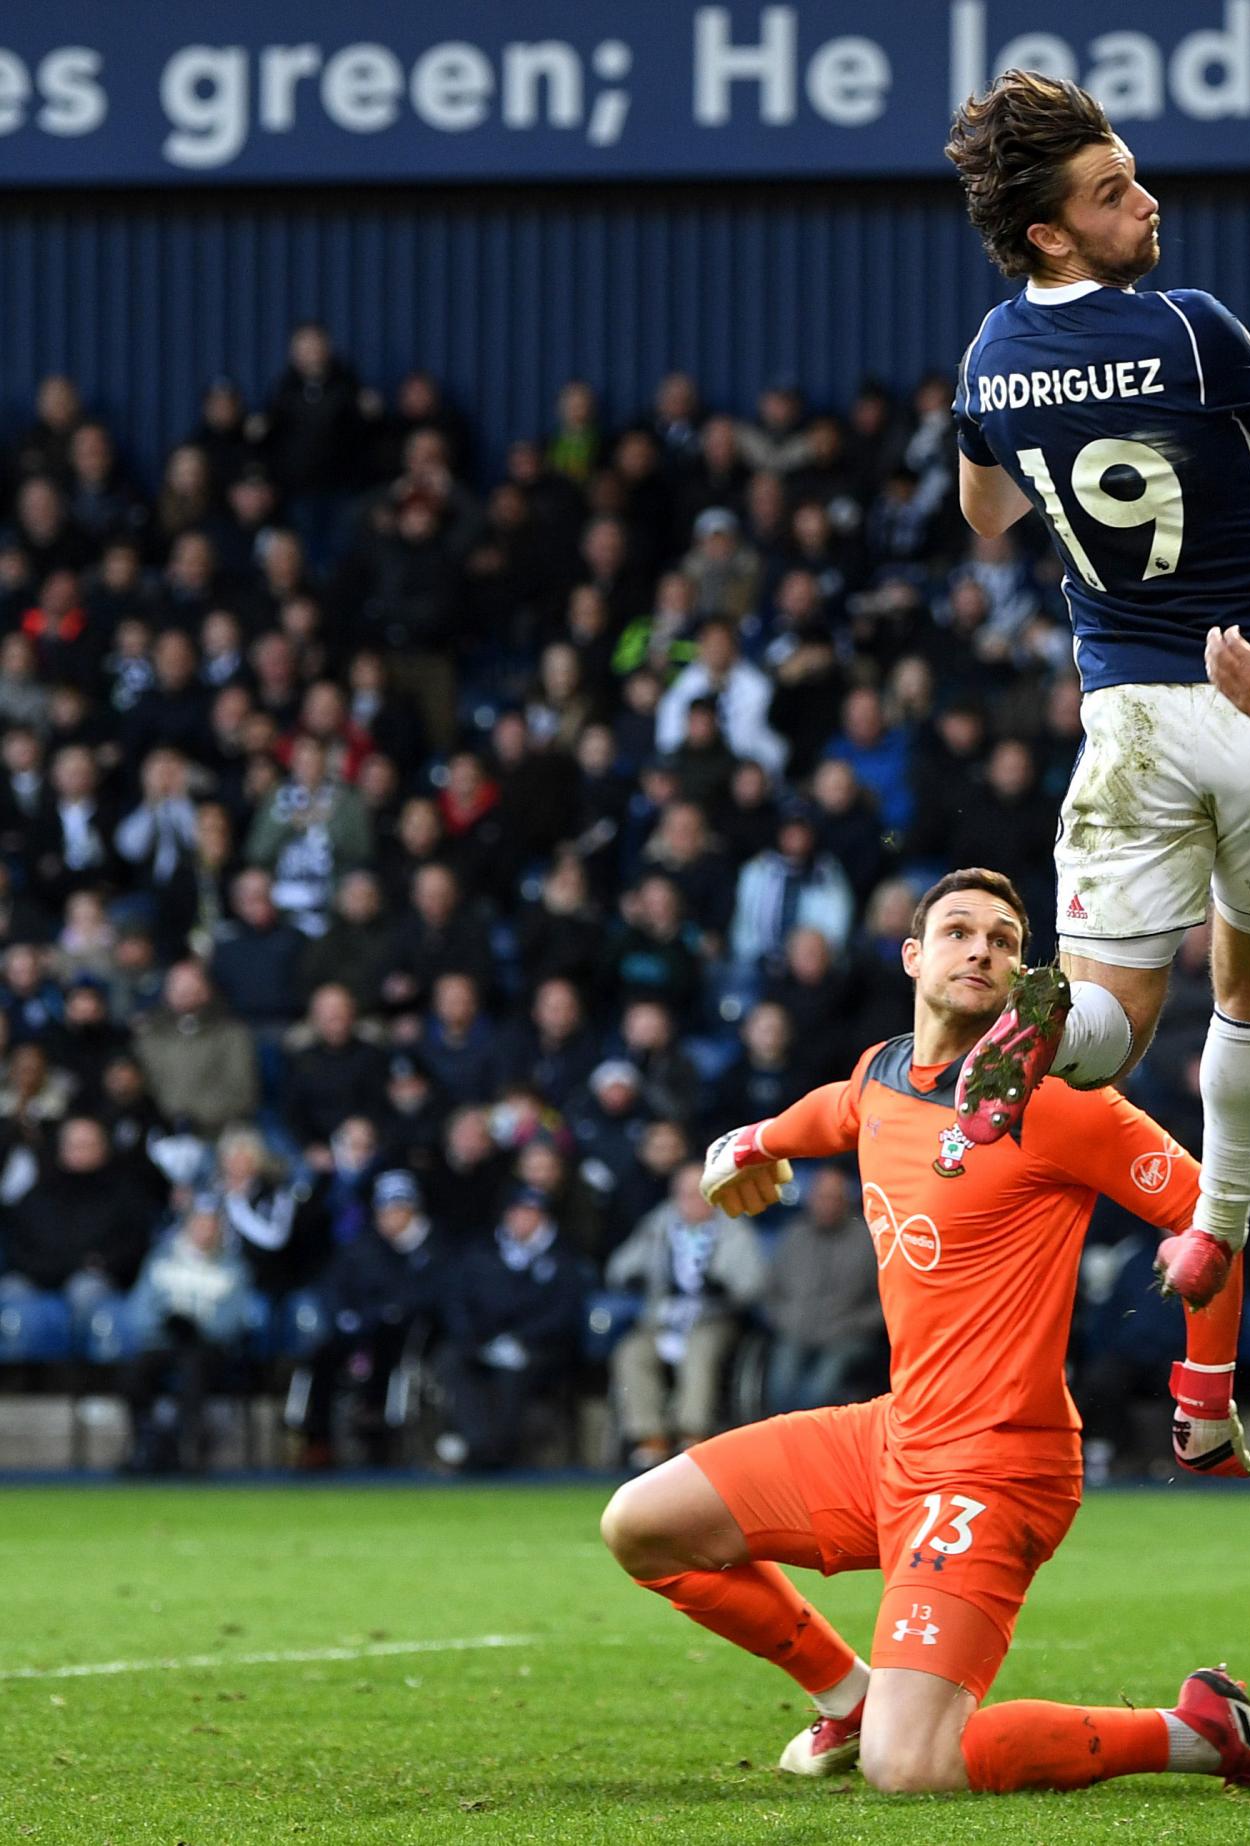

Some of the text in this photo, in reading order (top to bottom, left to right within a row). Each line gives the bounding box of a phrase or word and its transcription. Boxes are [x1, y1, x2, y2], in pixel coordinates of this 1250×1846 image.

[160, 37, 633, 170] green;
[692, 4, 893, 128] He
[979, 357, 1165, 413] RODRIGUEZ
[1016, 438, 1184, 592] 19
[911, 1494, 987, 1555] 13
[911, 1603, 933, 1620] 13
